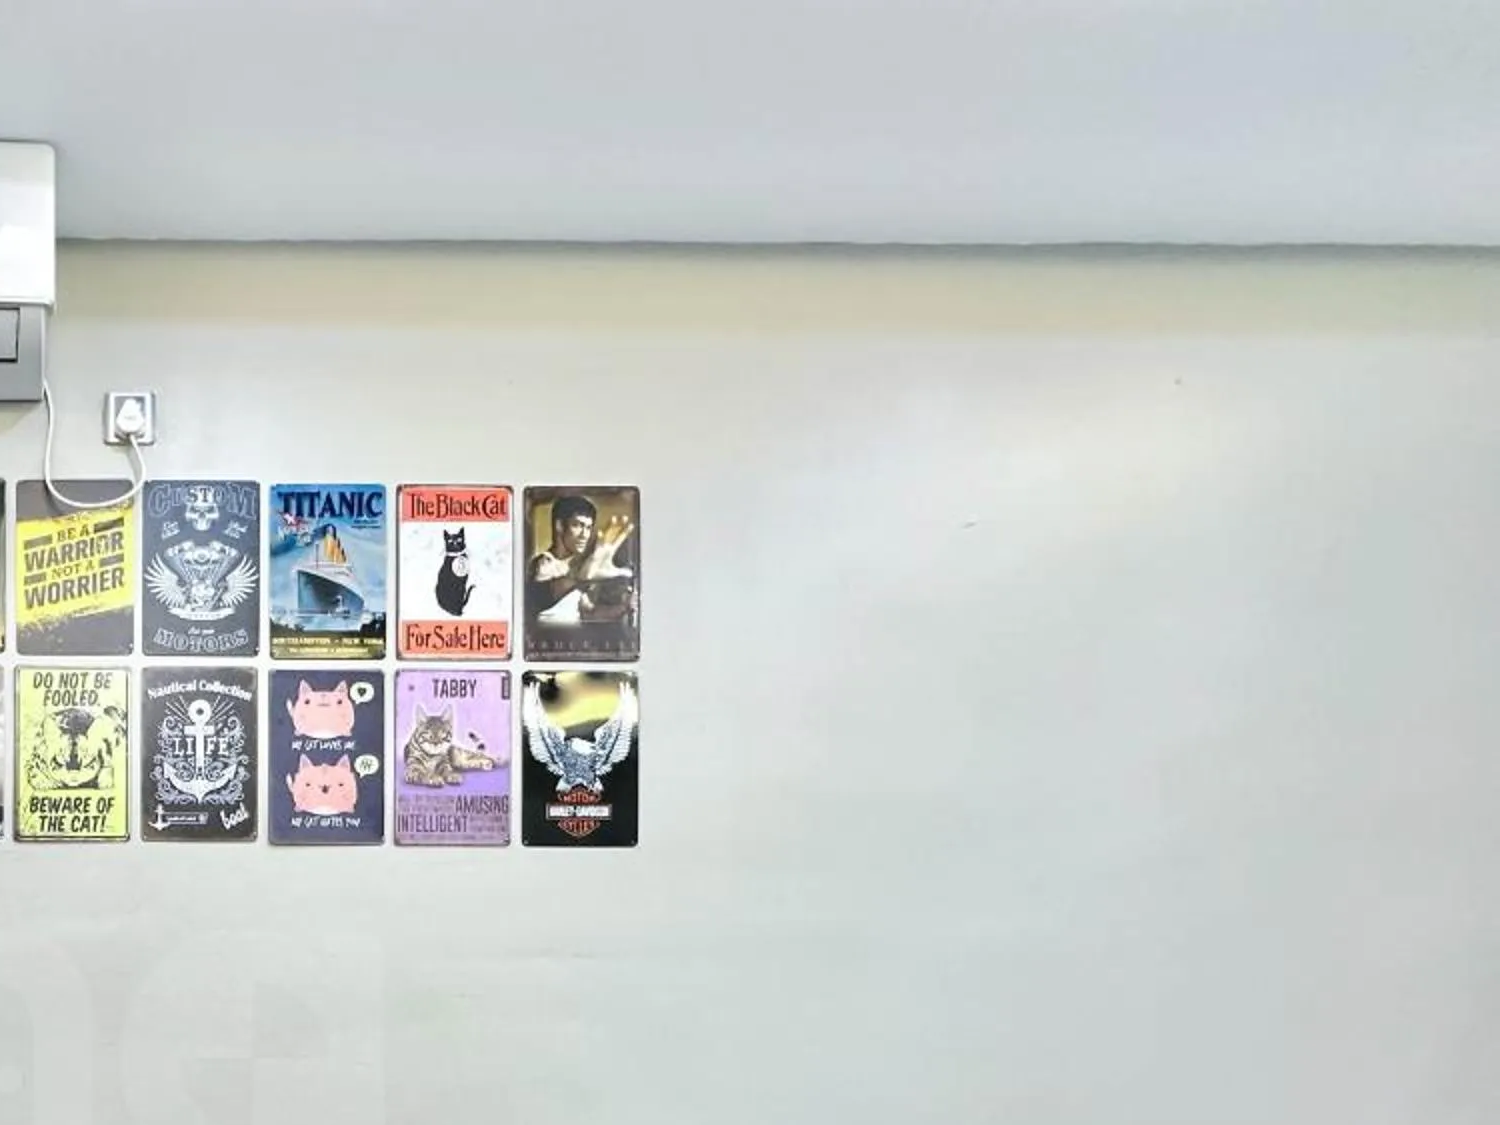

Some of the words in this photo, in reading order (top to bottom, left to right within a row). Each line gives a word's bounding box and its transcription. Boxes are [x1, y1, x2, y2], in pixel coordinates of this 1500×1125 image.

[149, 482, 257, 520] CUSTOM
[277, 491, 383, 518] TITANIC
[407, 492, 434, 518] The
[435, 493, 482, 518] Black
[482, 493, 507, 519] Cat
[57, 527, 77, 543] BE
[79, 523, 91, 538] A
[24, 531, 125, 573] WARRIOR
[51, 563, 81, 579] NOT
[85, 559, 96, 572] A
[24, 567, 125, 610] WORRIER
[406, 623, 432, 650] For
[433, 625, 467, 650] Sale
[469, 625, 505, 651] Here
[33, 672, 54, 689] DO
[59, 672, 89, 689] NOT
[93, 672, 113, 689] BE
[147, 679, 197, 699] Nautical
[199, 679, 253, 701] Collection
[432, 679, 477, 699] TABBY
[172, 737, 230, 756] LIFE
[30, 796, 92, 814] BEWARE
[96, 796, 116, 814] OF
[455, 794, 510, 814] AMUSING
[39, 815, 66, 832] THE
[71, 815, 107, 832] CAT!
[397, 814, 468, 832] INTELLIGENT
